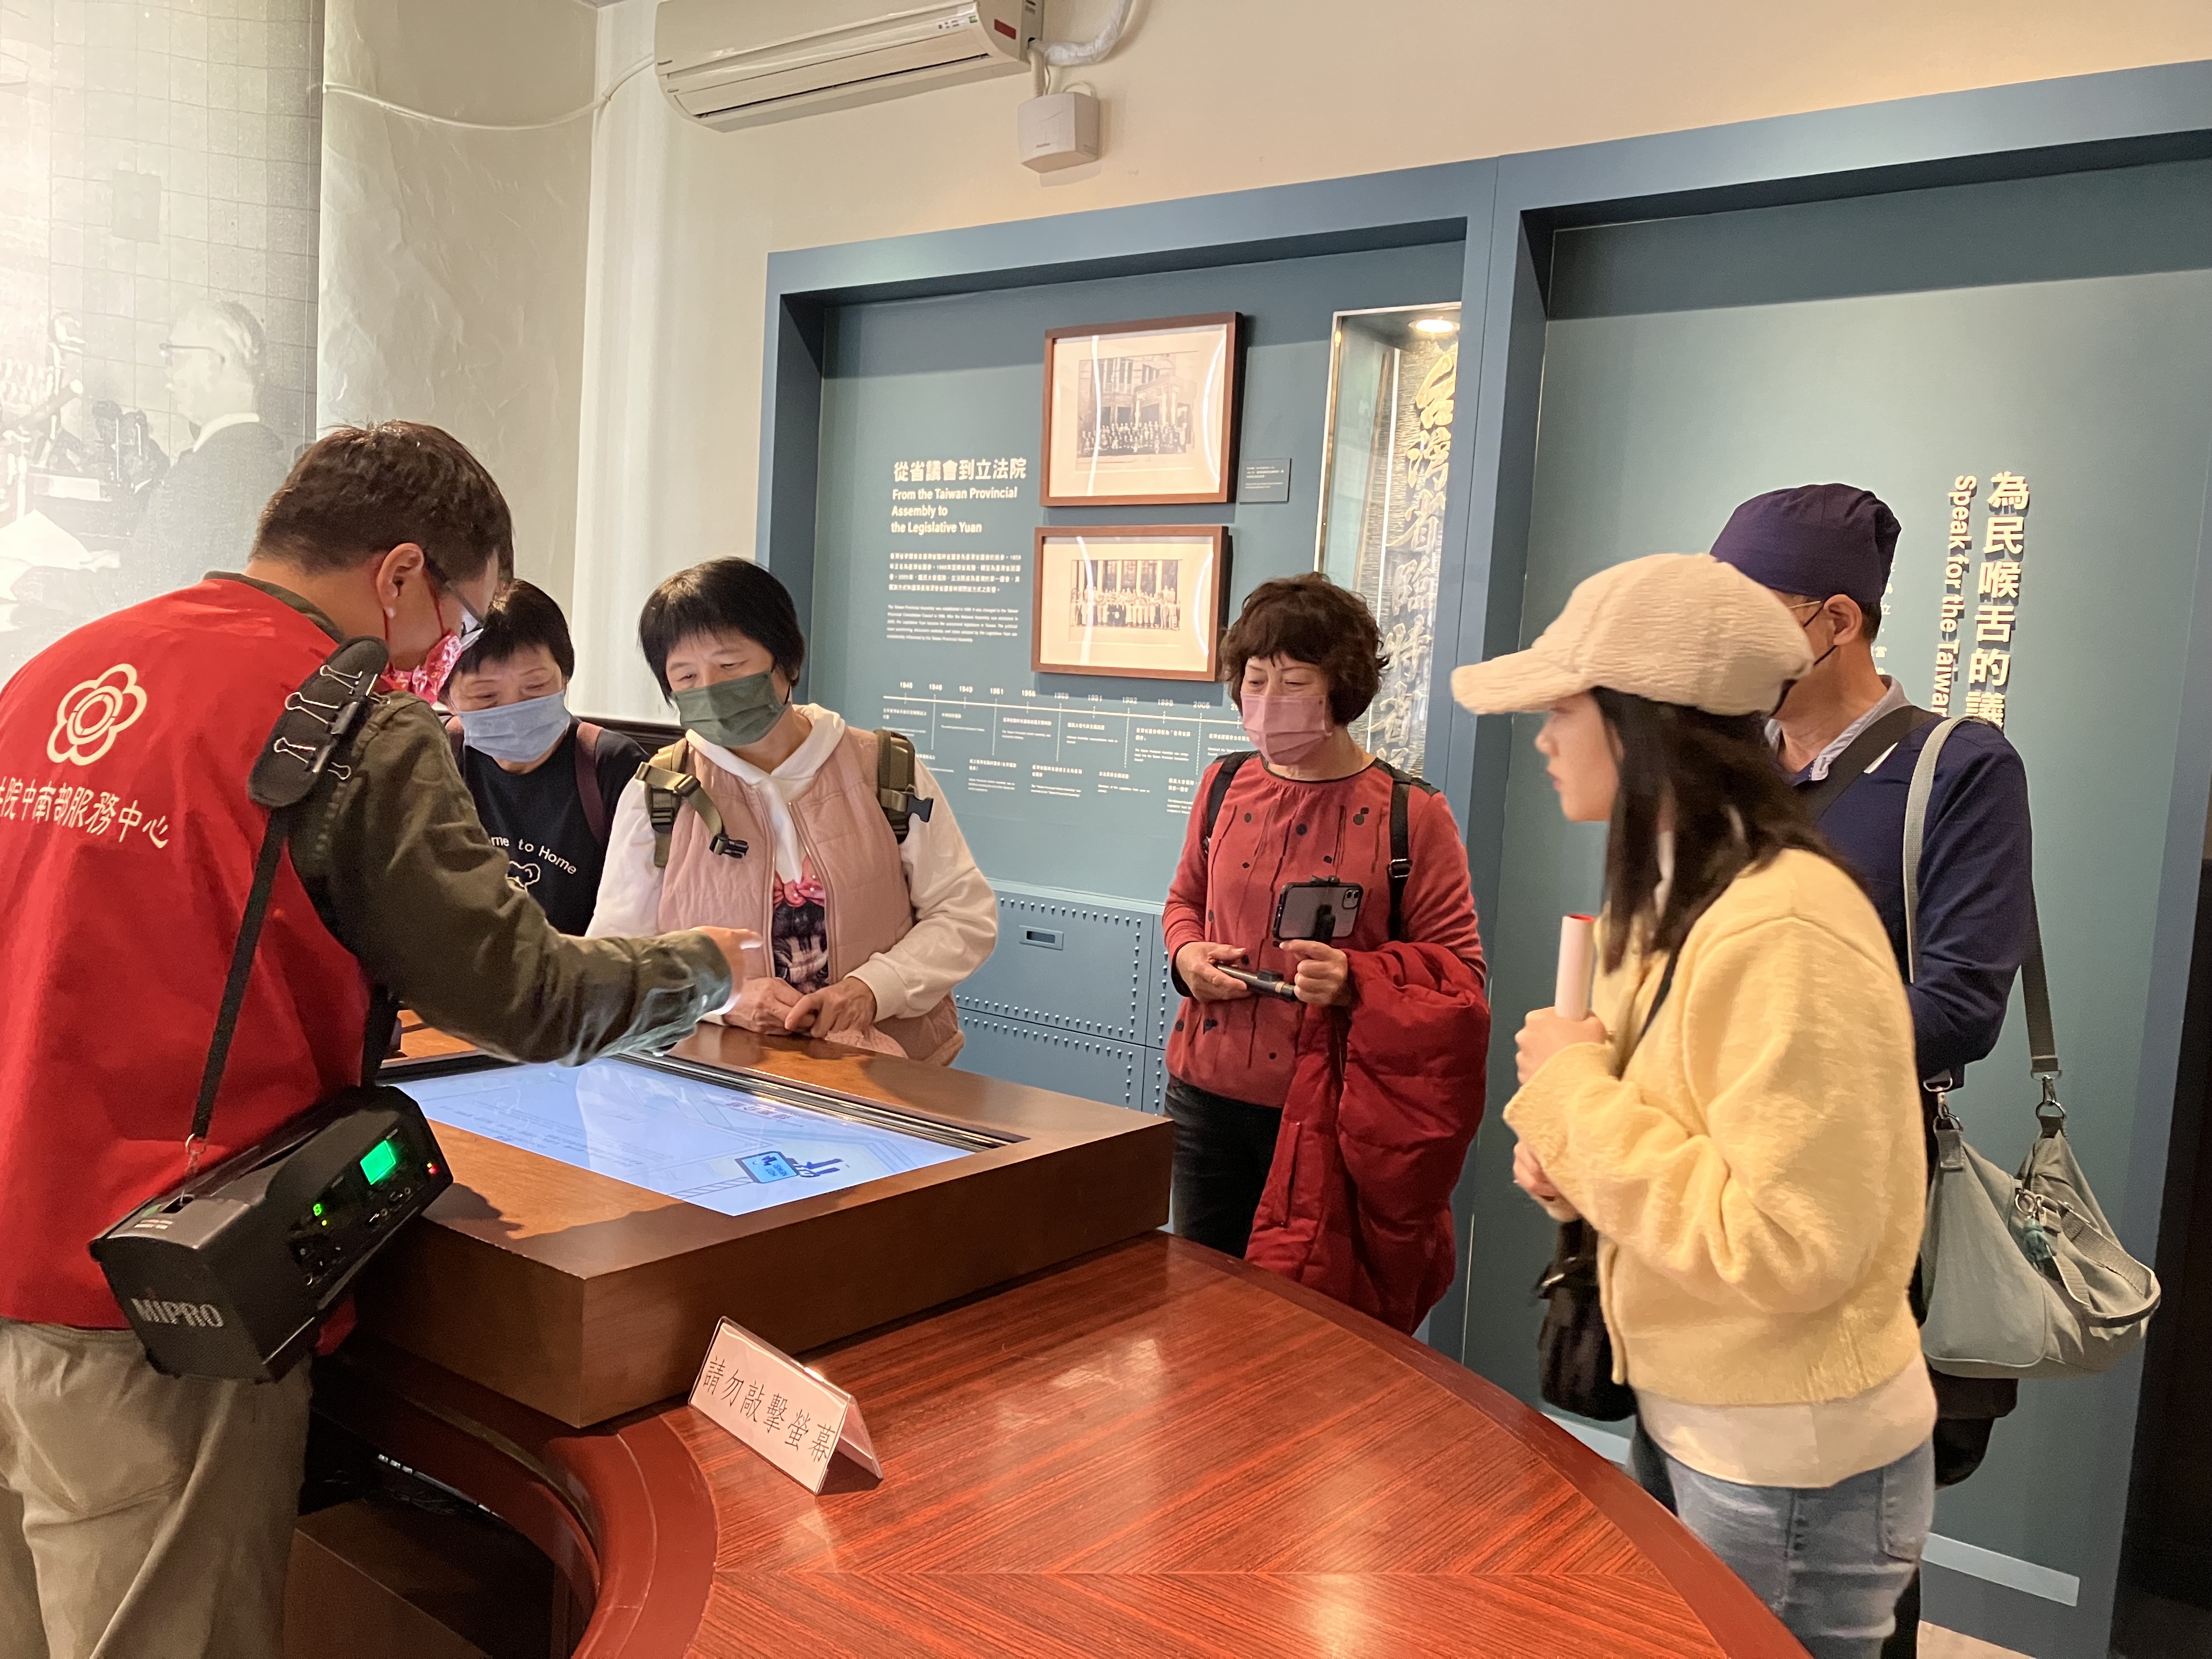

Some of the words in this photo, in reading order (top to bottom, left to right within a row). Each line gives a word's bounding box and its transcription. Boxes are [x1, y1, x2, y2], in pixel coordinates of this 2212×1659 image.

[894, 458, 1026, 482] 從省議會到立法院
[893, 489, 916, 500] From
[918, 488, 933, 500] the
[934, 487, 967, 499] Taiwan
[969, 486, 1018, 499] Provincial
[891, 504, 936, 519] Assembly
[938, 505, 948, 516] to
[1948, 475, 1977, 549] Speak
[891, 521, 906, 533] the
[907, 521, 957, 535] Legislative
[959, 522, 982, 533] Yuan
[1944, 554, 1970, 589] for
[1940, 594, 1965, 633] the
[518, 839, 534, 853] to
[538, 845, 577, 874] Home
[131, 1298, 224, 1327] MIPRO
[703, 1356, 836, 1463] 請勿敲擊螢幕
